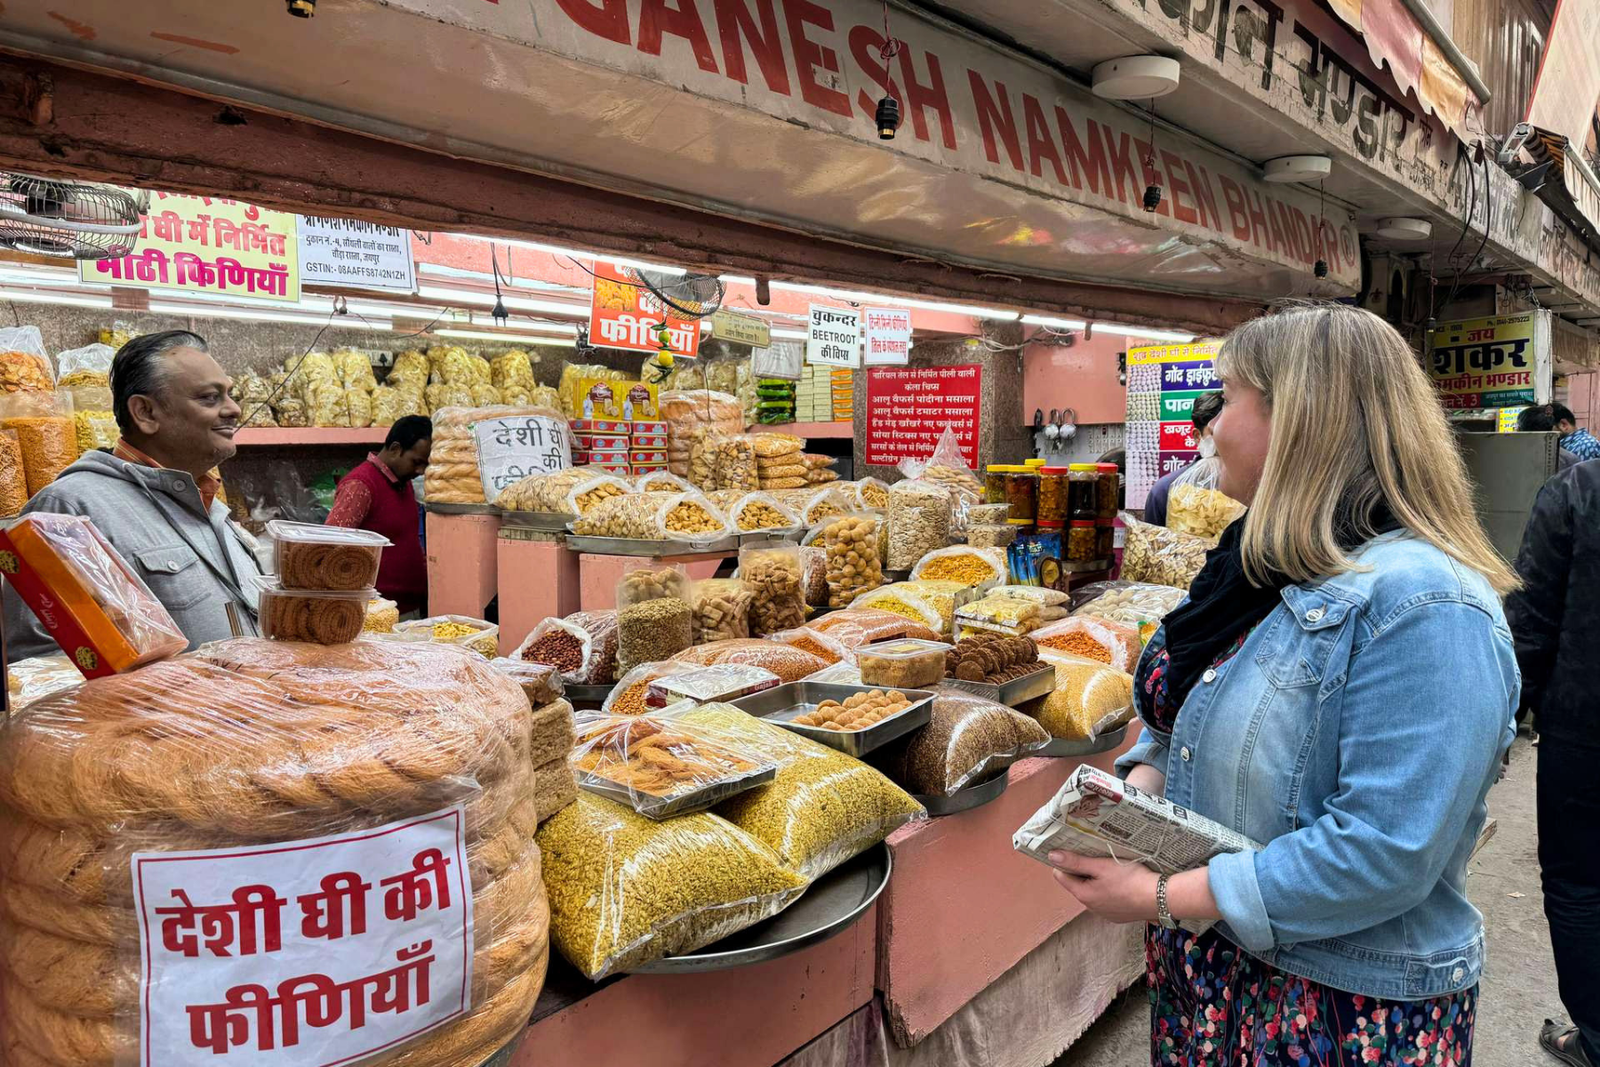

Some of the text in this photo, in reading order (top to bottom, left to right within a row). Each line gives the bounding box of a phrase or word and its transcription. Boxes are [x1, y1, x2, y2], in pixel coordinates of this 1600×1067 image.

[968, 69, 1222, 232] NAMKEEN
[1218, 174, 1341, 273] BHANDAR
[151, 210, 184, 243] घी
[186, 213, 212, 246] में
[213, 217, 287, 257] निर्मित
[812, 309, 857, 327] चुकन्दर
[812, 329, 856, 345] BEETROOT
[1467, 328, 1495, 342] जय
[821, 344, 832, 360] की
[1433, 336, 1530, 375] शंकर
[1165, 365, 1184, 384] गोंद
[1486, 371, 1532, 388] भण्डार
[1470, 394, 1478, 407] 3
[916, 407, 942, 416] टमाटर
[493, 418, 543, 447] देशी
[1164, 425, 1192, 436] खजूर
[541, 447, 562, 470] की
[155, 848, 451, 957] देशी घी की
[186, 940, 435, 1054] फीणियाँ
